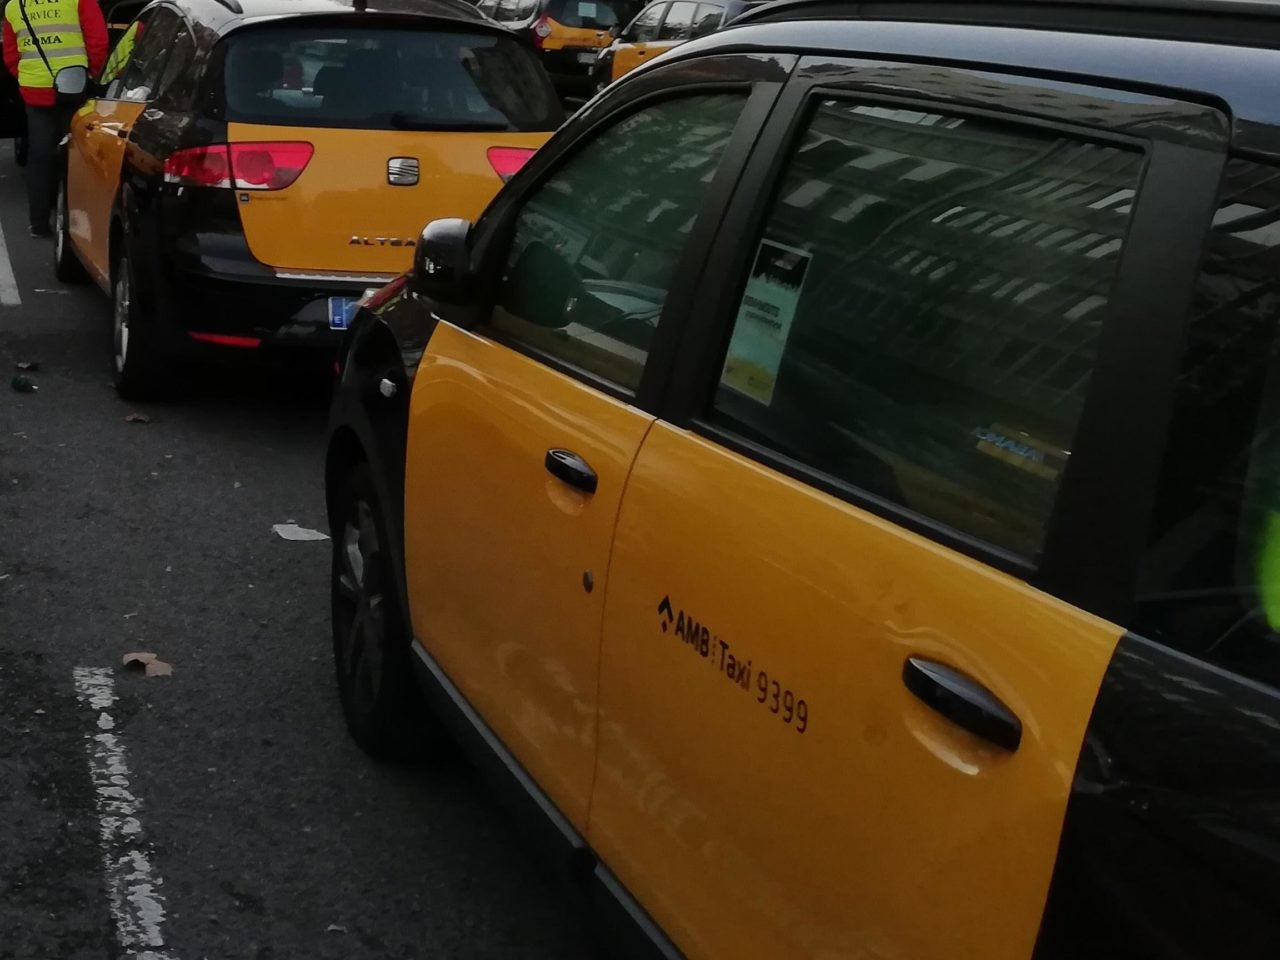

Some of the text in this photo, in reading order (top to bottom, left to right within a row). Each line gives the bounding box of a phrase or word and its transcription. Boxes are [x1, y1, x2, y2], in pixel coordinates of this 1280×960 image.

[348, 235, 417, 248] ALTEA
[674, 609, 809, 735] AMB Taxi 9399
